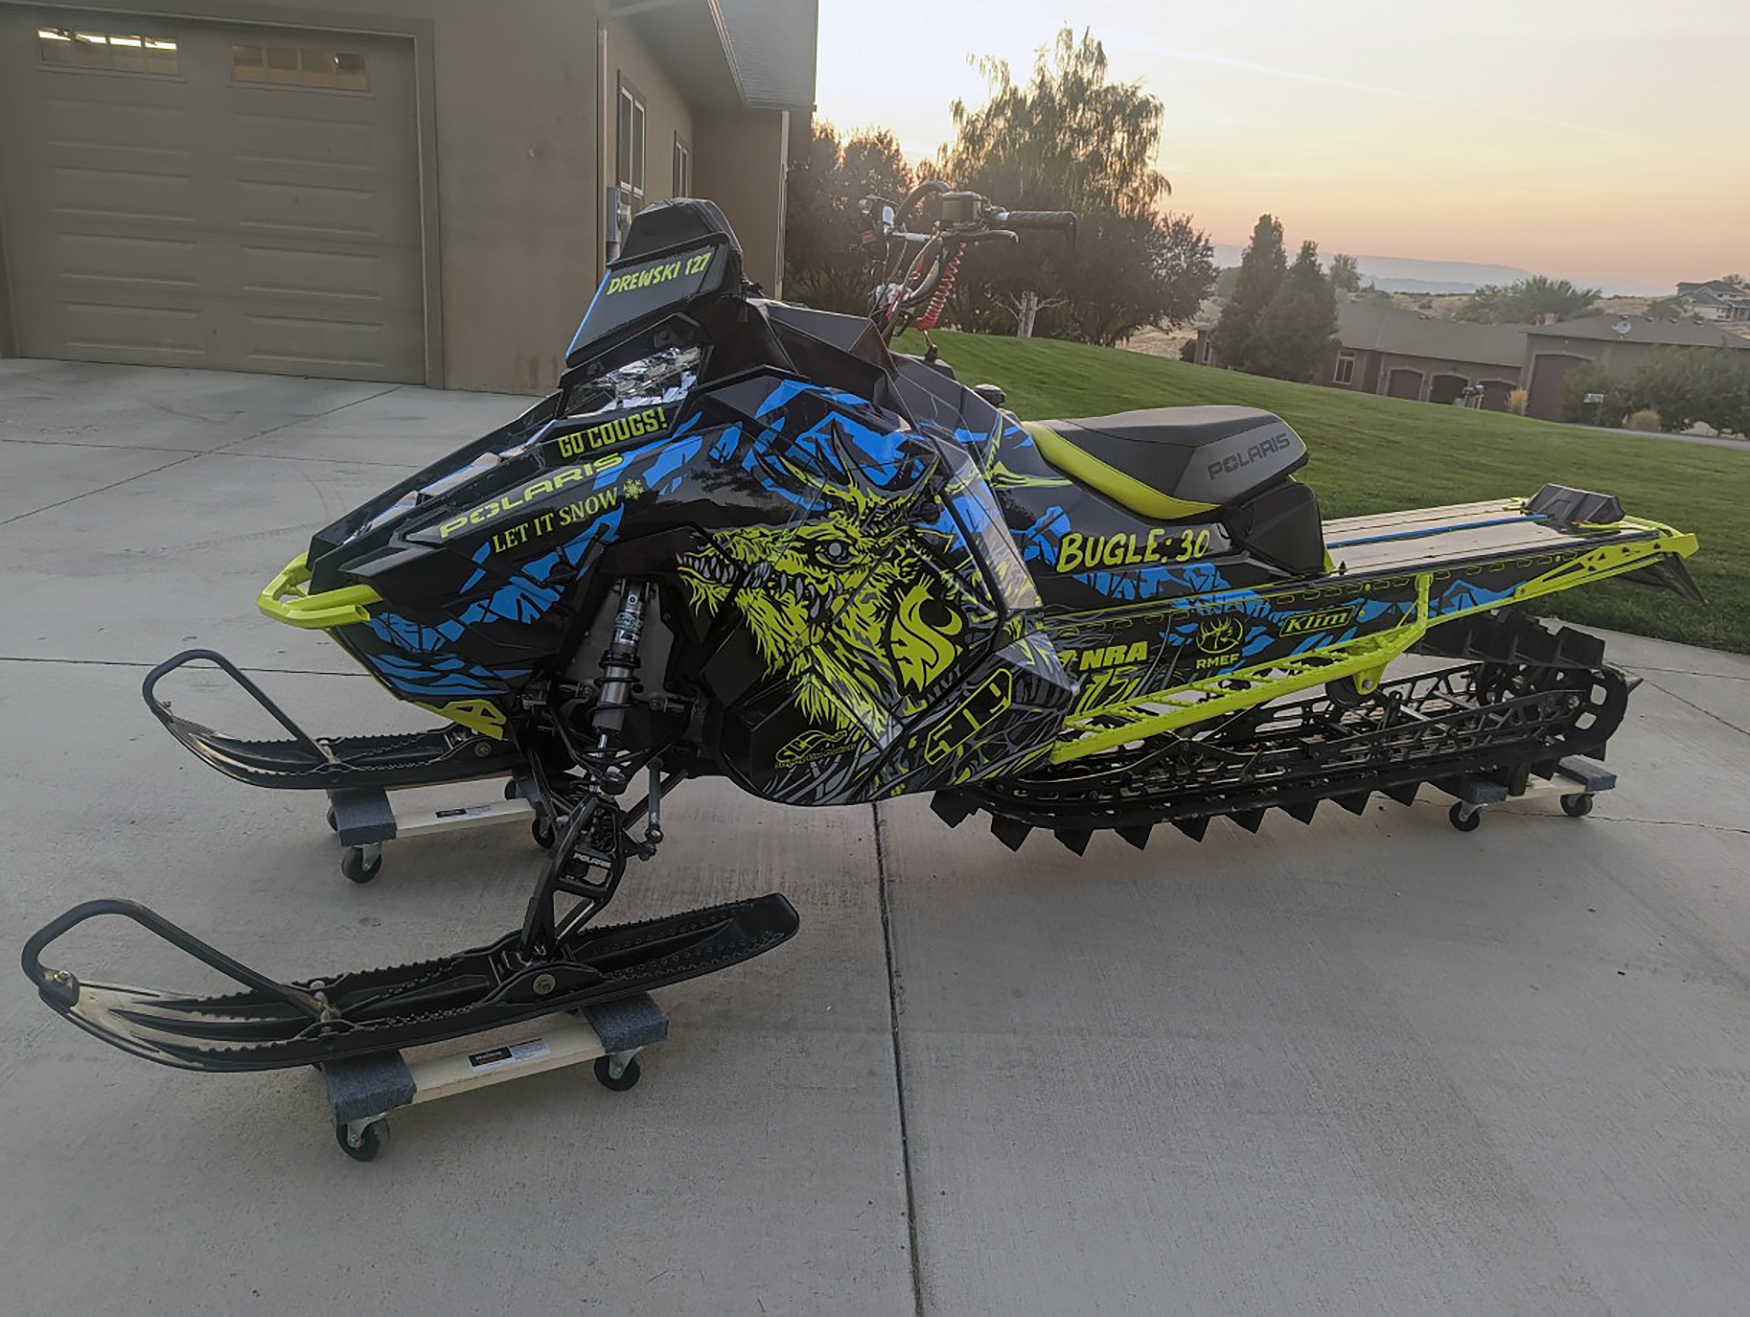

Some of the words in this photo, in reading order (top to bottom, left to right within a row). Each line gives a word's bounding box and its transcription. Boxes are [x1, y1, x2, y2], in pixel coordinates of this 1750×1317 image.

[607, 261, 681, 295] DREWSKI
[685, 252, 711, 275] 127
[558, 433, 584, 457] GO
[589, 407, 667, 448] COUGS!
[1207, 432, 1291, 480] POLARIS
[440, 452, 624, 538] POLARIS
[492, 521, 528, 553] LET
[533, 513, 554, 537] IT
[559, 487, 619, 526] SNOW
[1175, 529, 1210, 562] 30
[1079, 641, 1148, 671] NRA
[1195, 653, 1240, 669] RMEF
